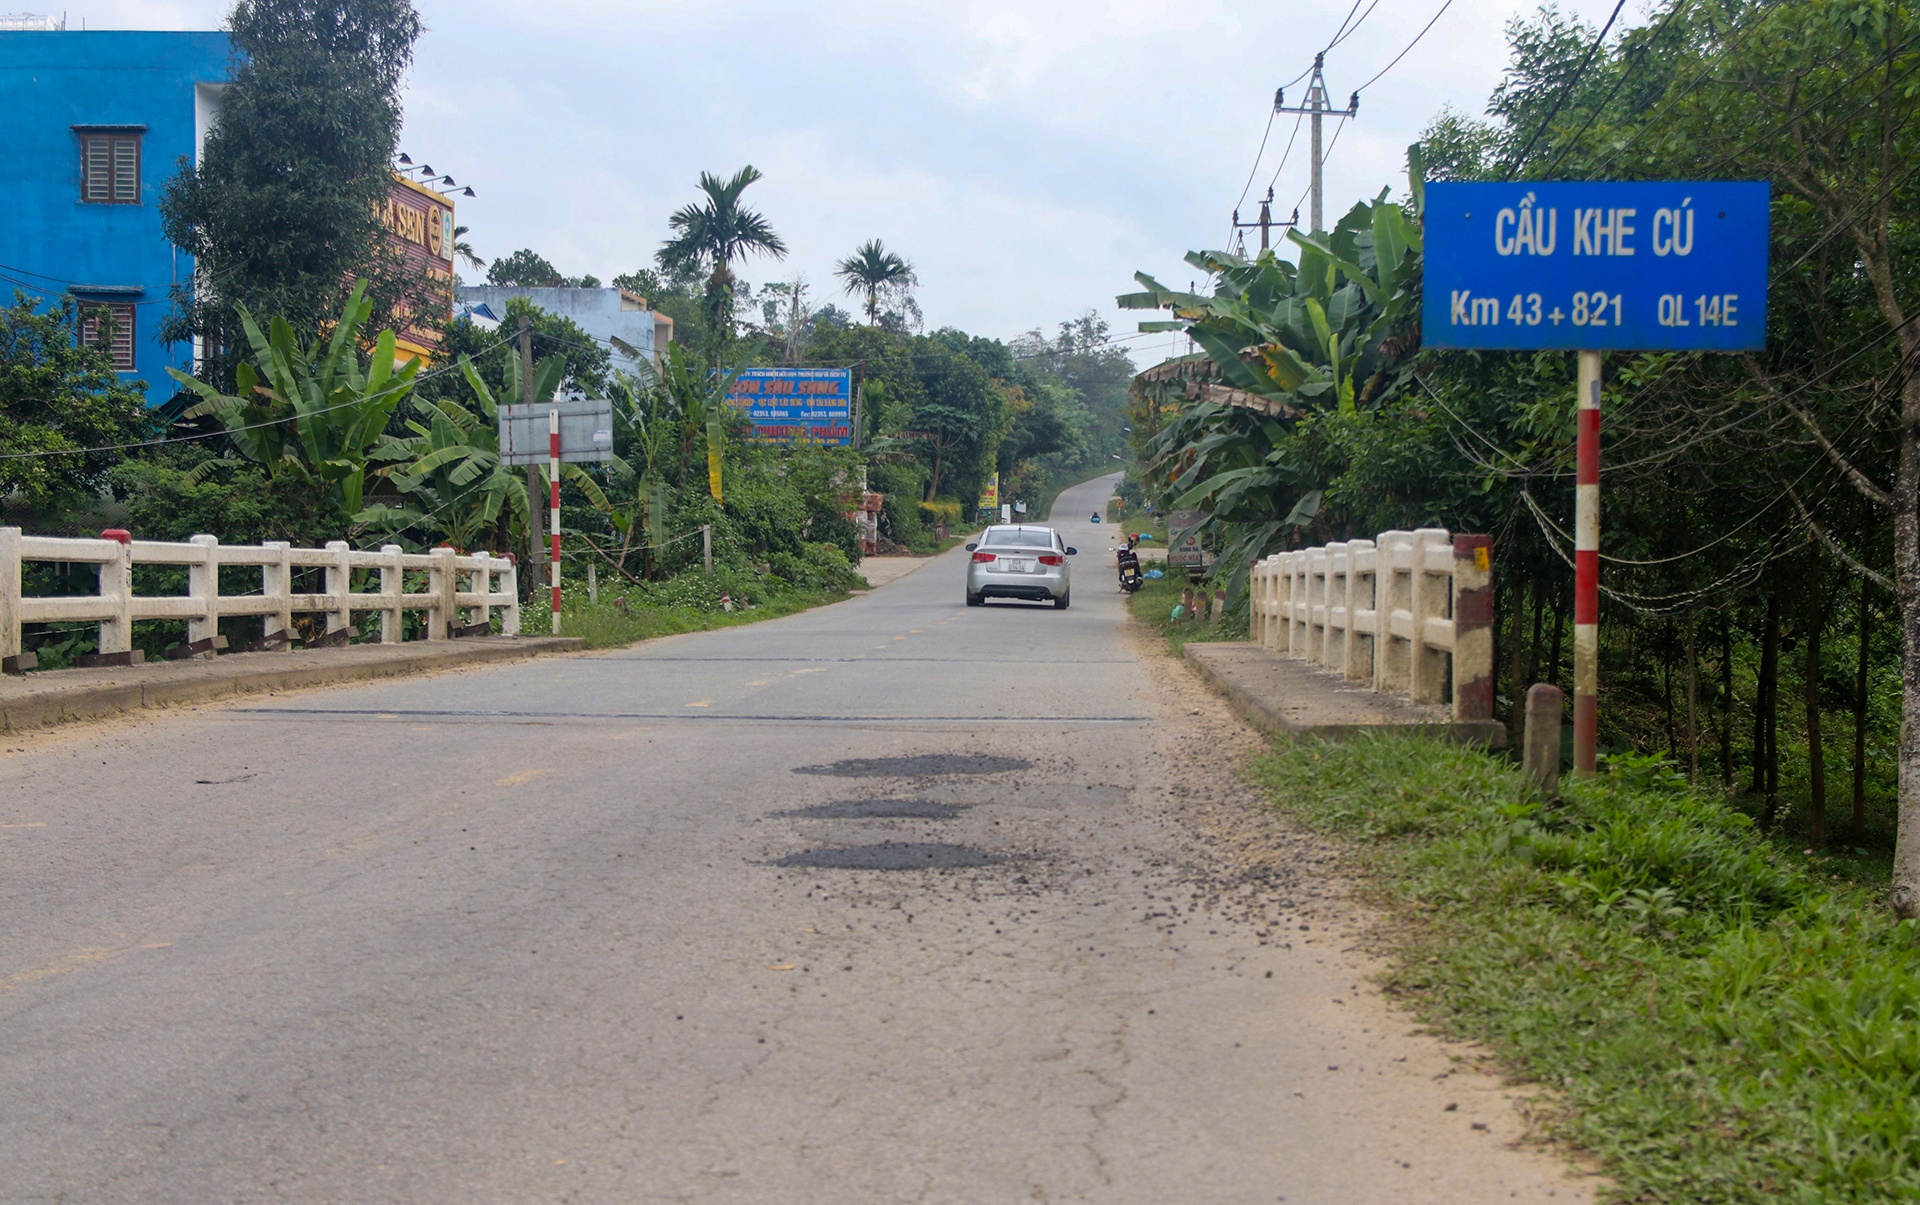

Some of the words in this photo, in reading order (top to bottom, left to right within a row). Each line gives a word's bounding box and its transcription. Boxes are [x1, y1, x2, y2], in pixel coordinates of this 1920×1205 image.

[1495, 192, 1557, 257] CẦU
[1573, 208, 1636, 256] KHE
[1652, 197, 1694, 257] CÚ
